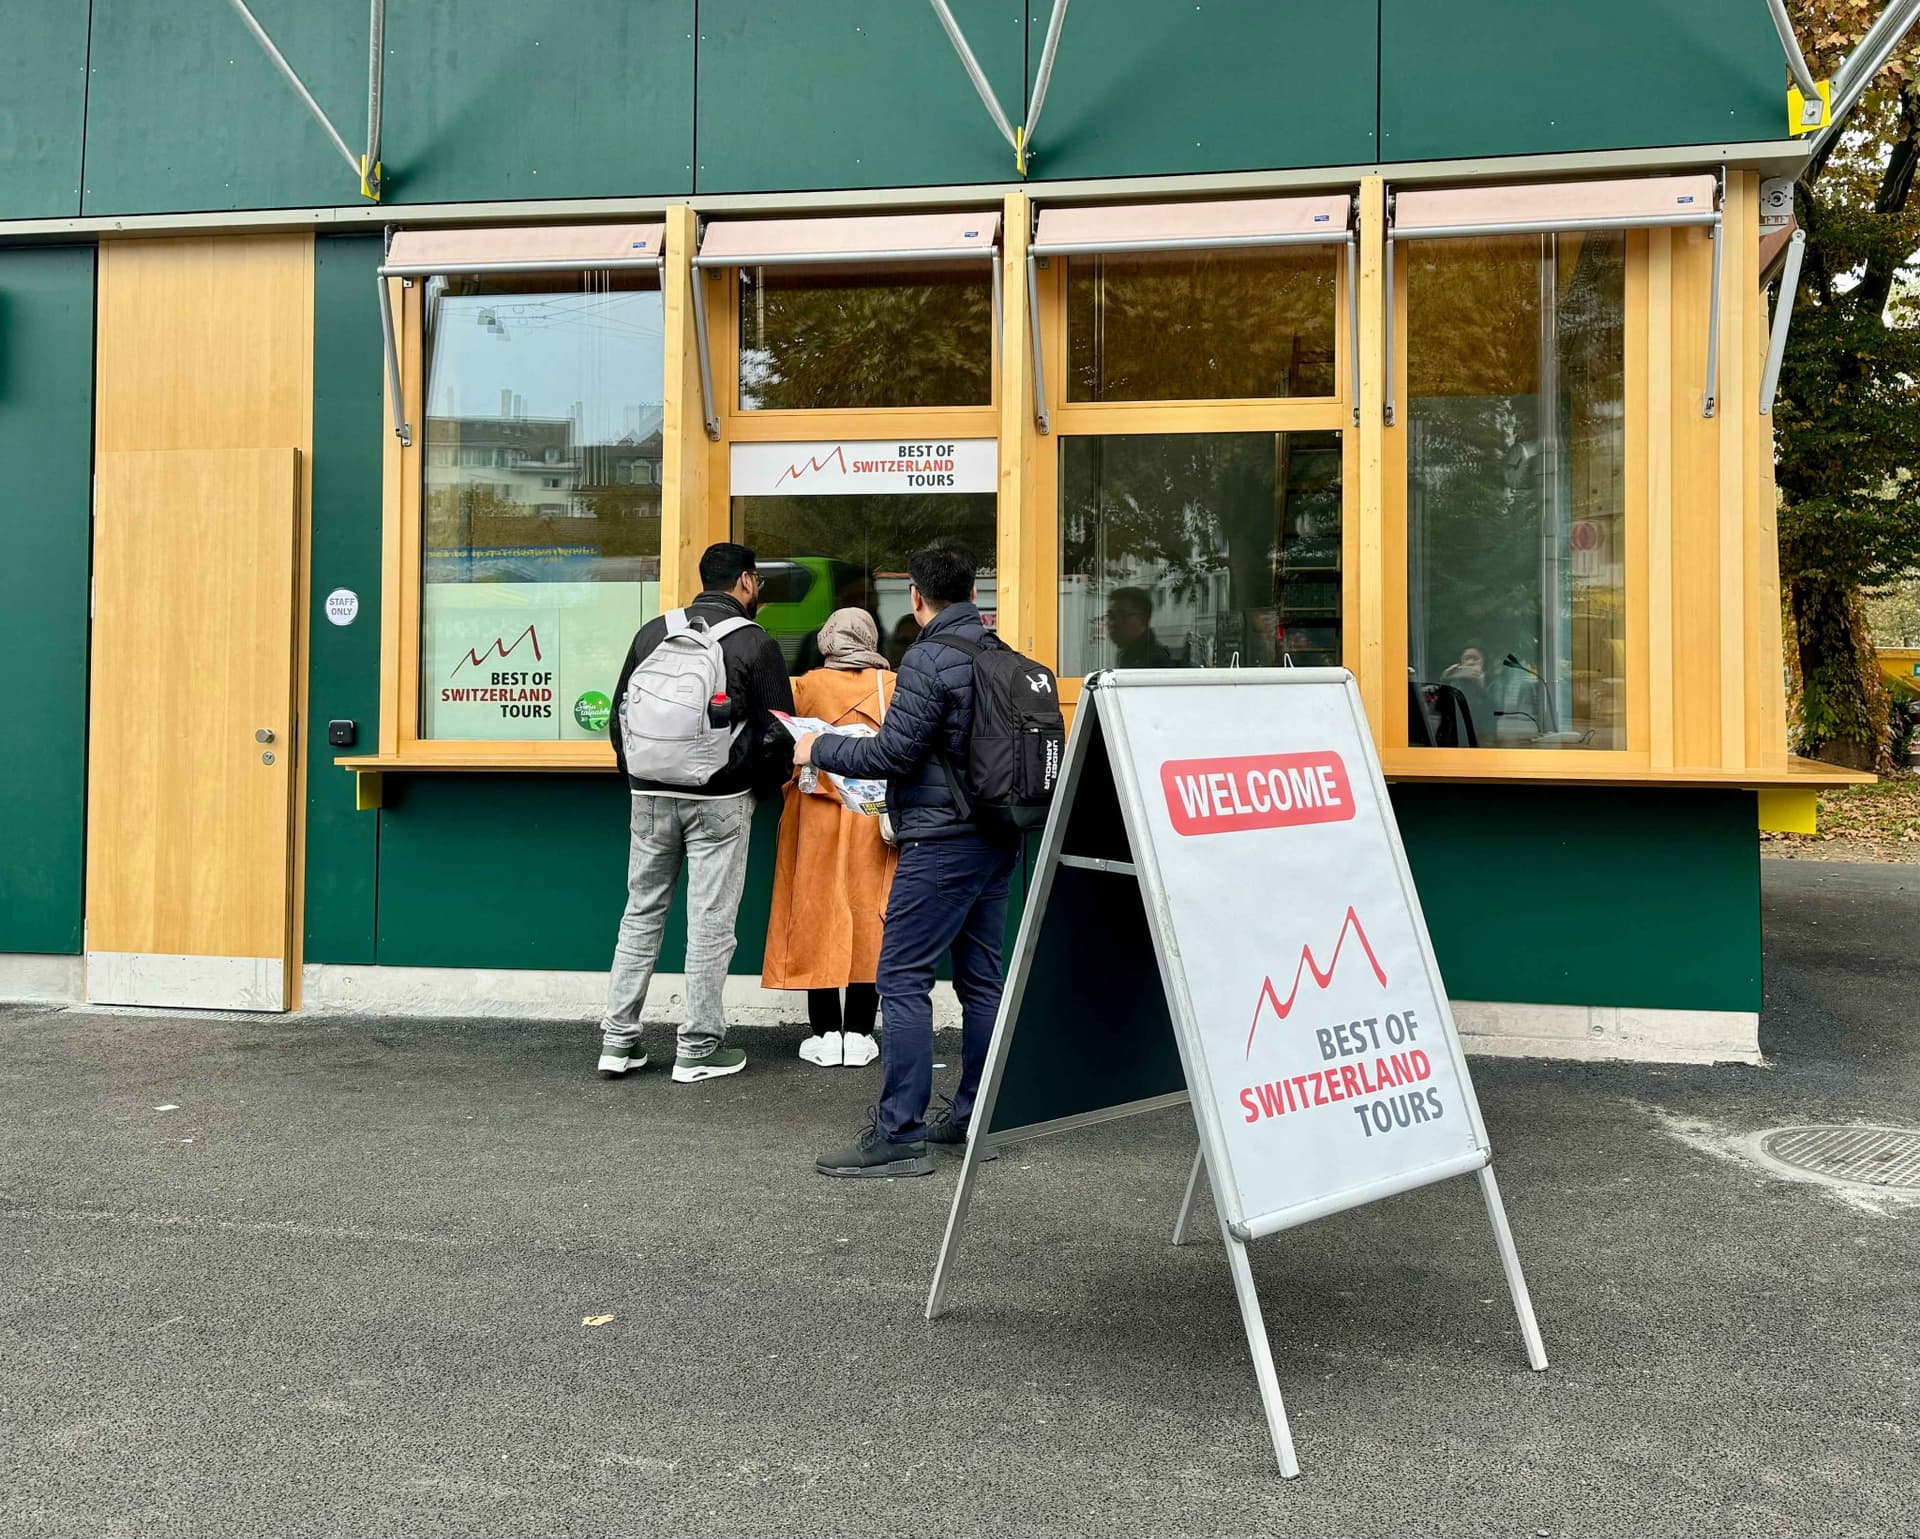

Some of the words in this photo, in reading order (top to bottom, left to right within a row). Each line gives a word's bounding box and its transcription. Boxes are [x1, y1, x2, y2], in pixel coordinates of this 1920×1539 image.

[898, 445, 933, 458] BEST
[935, 444, 955, 457] OF
[852, 459, 954, 473] SWITZERLAND
[907, 474, 954, 487] TOURS
[329, 598, 355, 606] STAFF
[331, 607, 353, 616] ONLY
[491, 672, 528, 686] BEST
[532, 672, 552, 686] OF
[441, 688, 552, 702] SWITZERLAND
[500, 704, 552, 718] TOURS
[1043, 739, 1053, 790] ARMOUR
[1051, 739, 1059, 779] UNDER
[1174, 765, 1342, 819] WELCOME
[1315, 1017, 1381, 1061] BEST
[1385, 1010, 1418, 1045] OF
[1239, 1049, 1432, 1124] SWITZERLAND
[1353, 1086, 1444, 1138] TOURS
